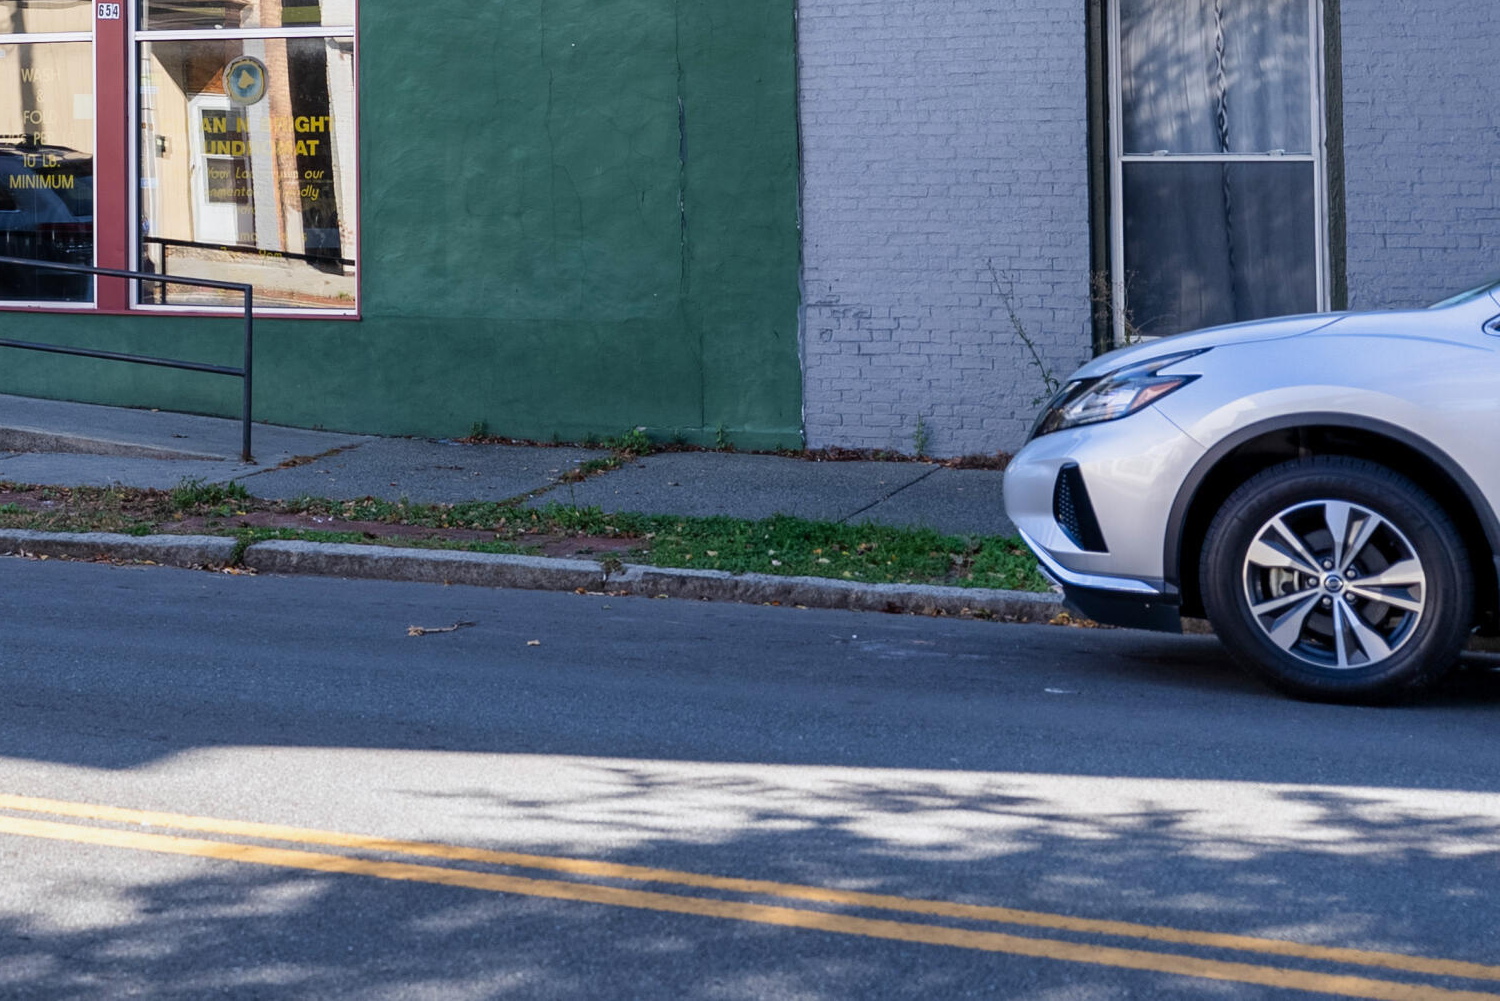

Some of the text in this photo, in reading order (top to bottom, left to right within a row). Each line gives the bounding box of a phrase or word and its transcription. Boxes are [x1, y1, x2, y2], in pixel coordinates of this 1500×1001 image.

[98, 4, 118, 17] 654
[36, 89, 45, 102] &
[22, 154, 36, 168] 10
[304, 169, 325, 180] our
[9, 174, 74, 189] MINIMUM
